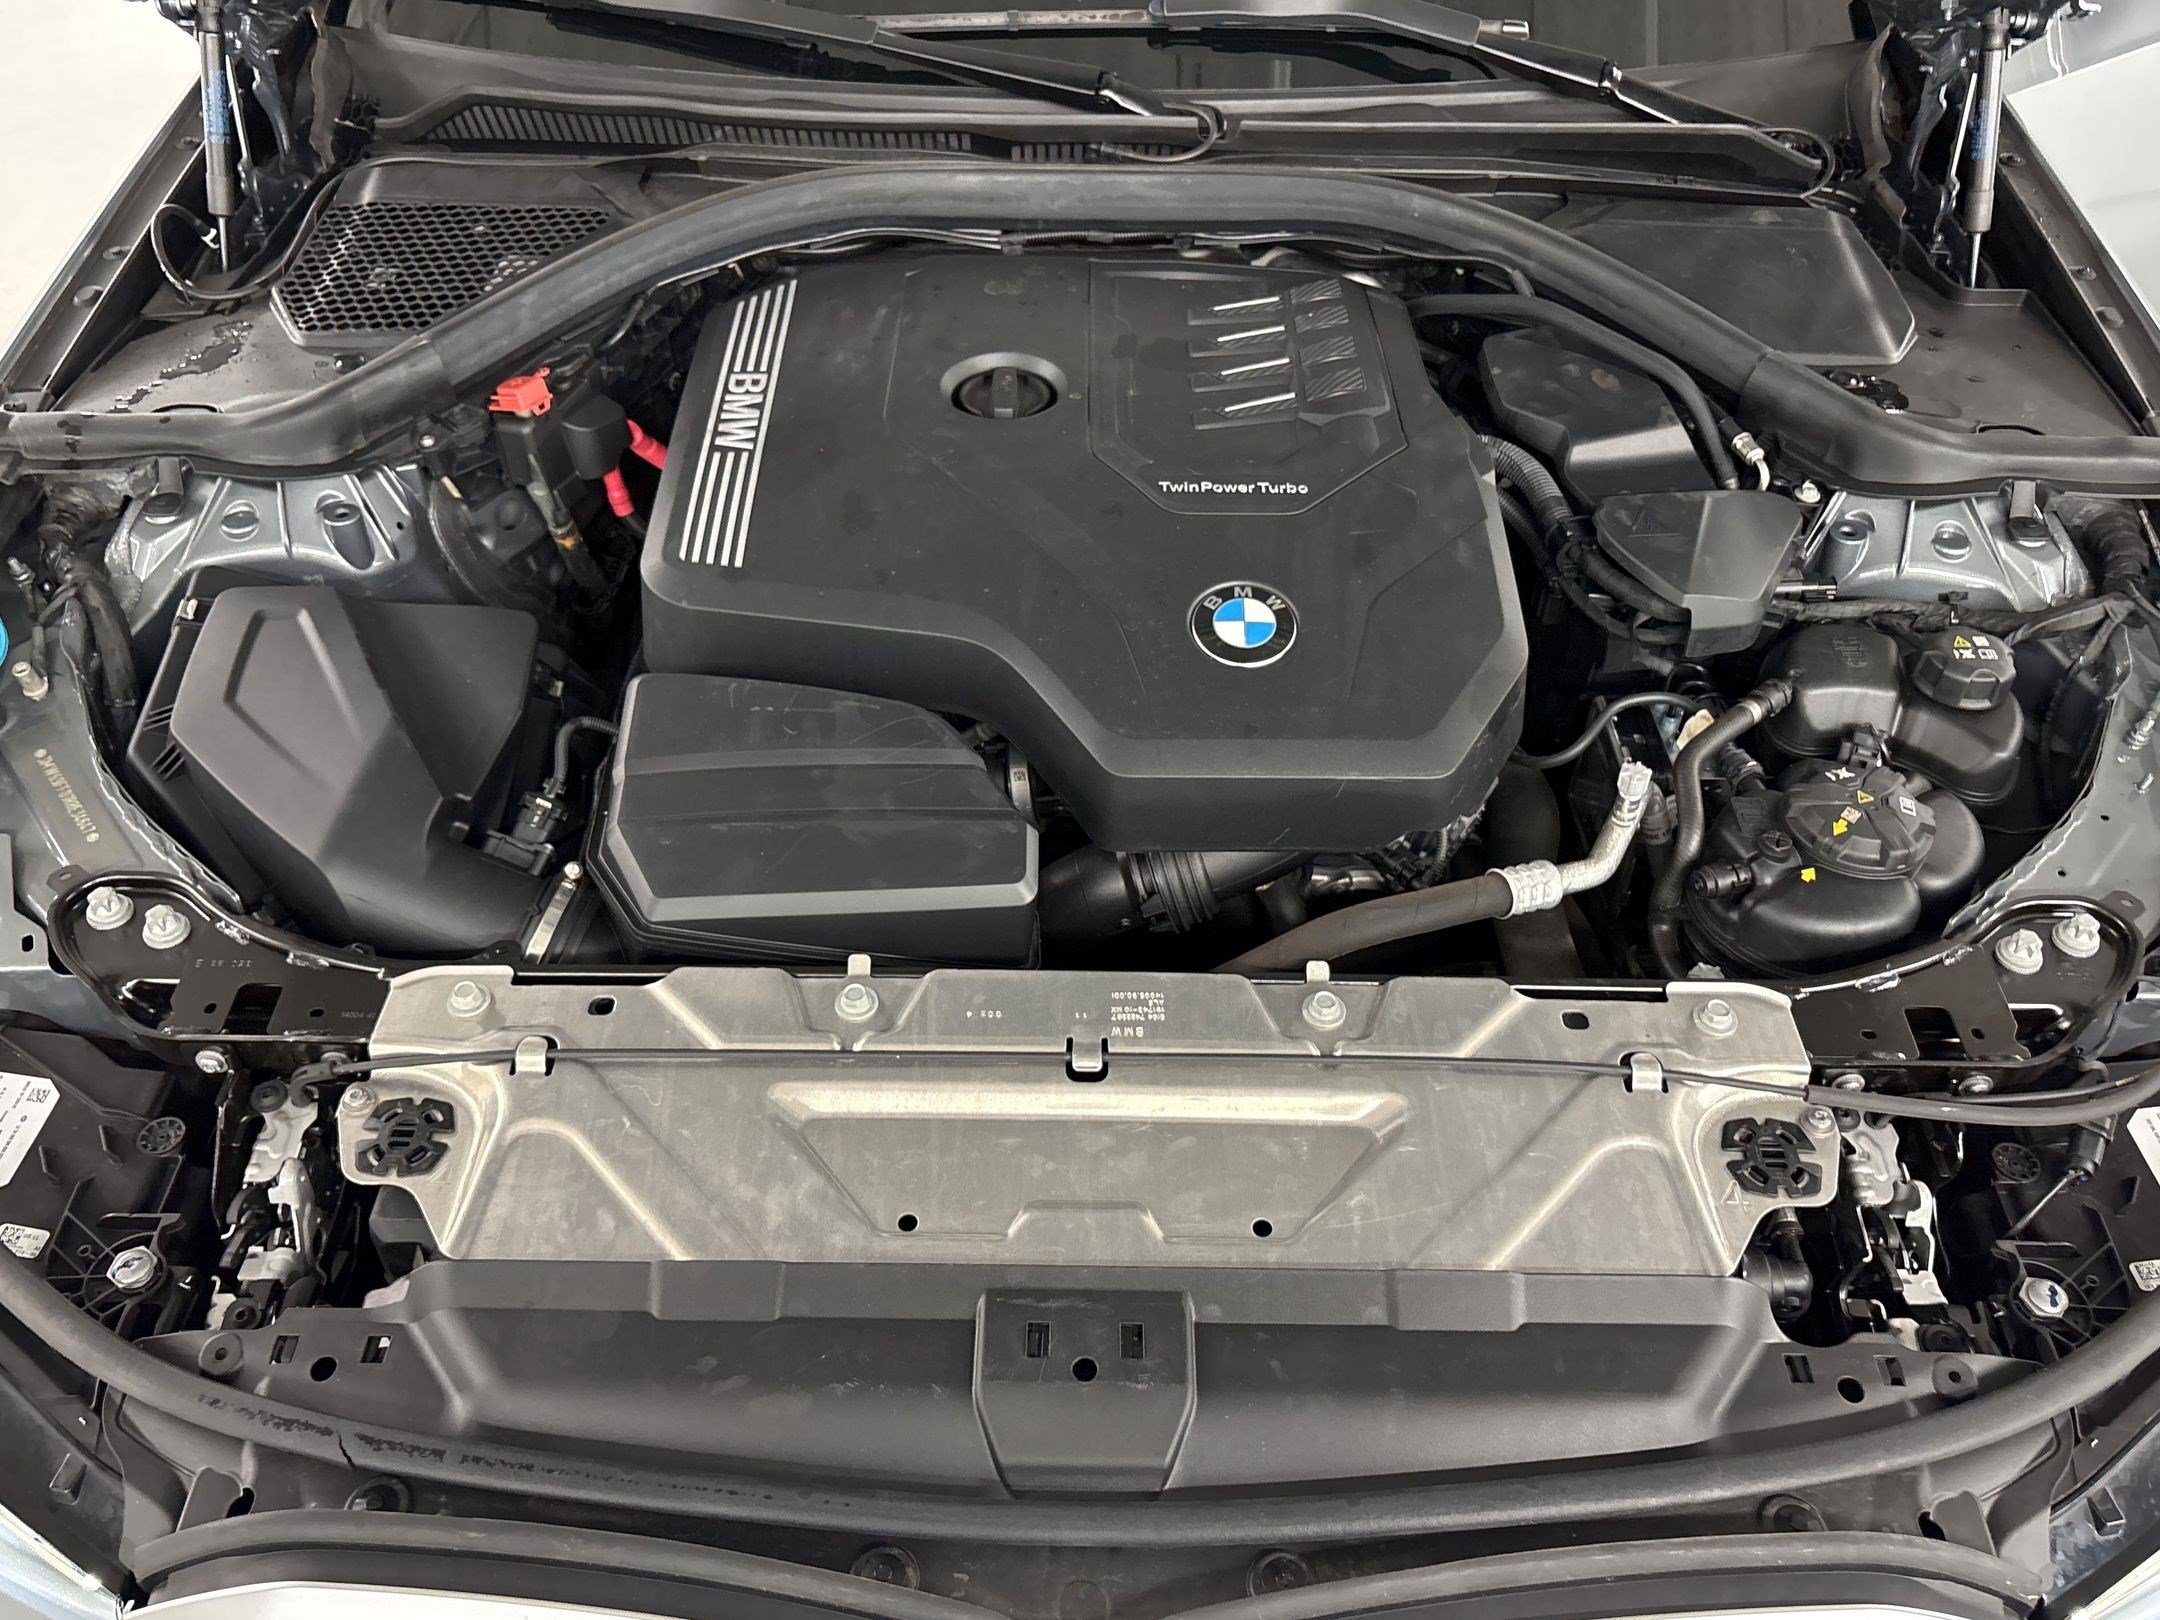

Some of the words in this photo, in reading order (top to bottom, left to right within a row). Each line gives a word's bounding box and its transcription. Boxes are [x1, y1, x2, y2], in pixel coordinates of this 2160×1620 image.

[714, 372, 769, 450] BMW
[1257, 482, 1309, 494] Turbo
[1203, 586, 1287, 611] BMW
[1110, 1026, 1144, 1038] BMW
